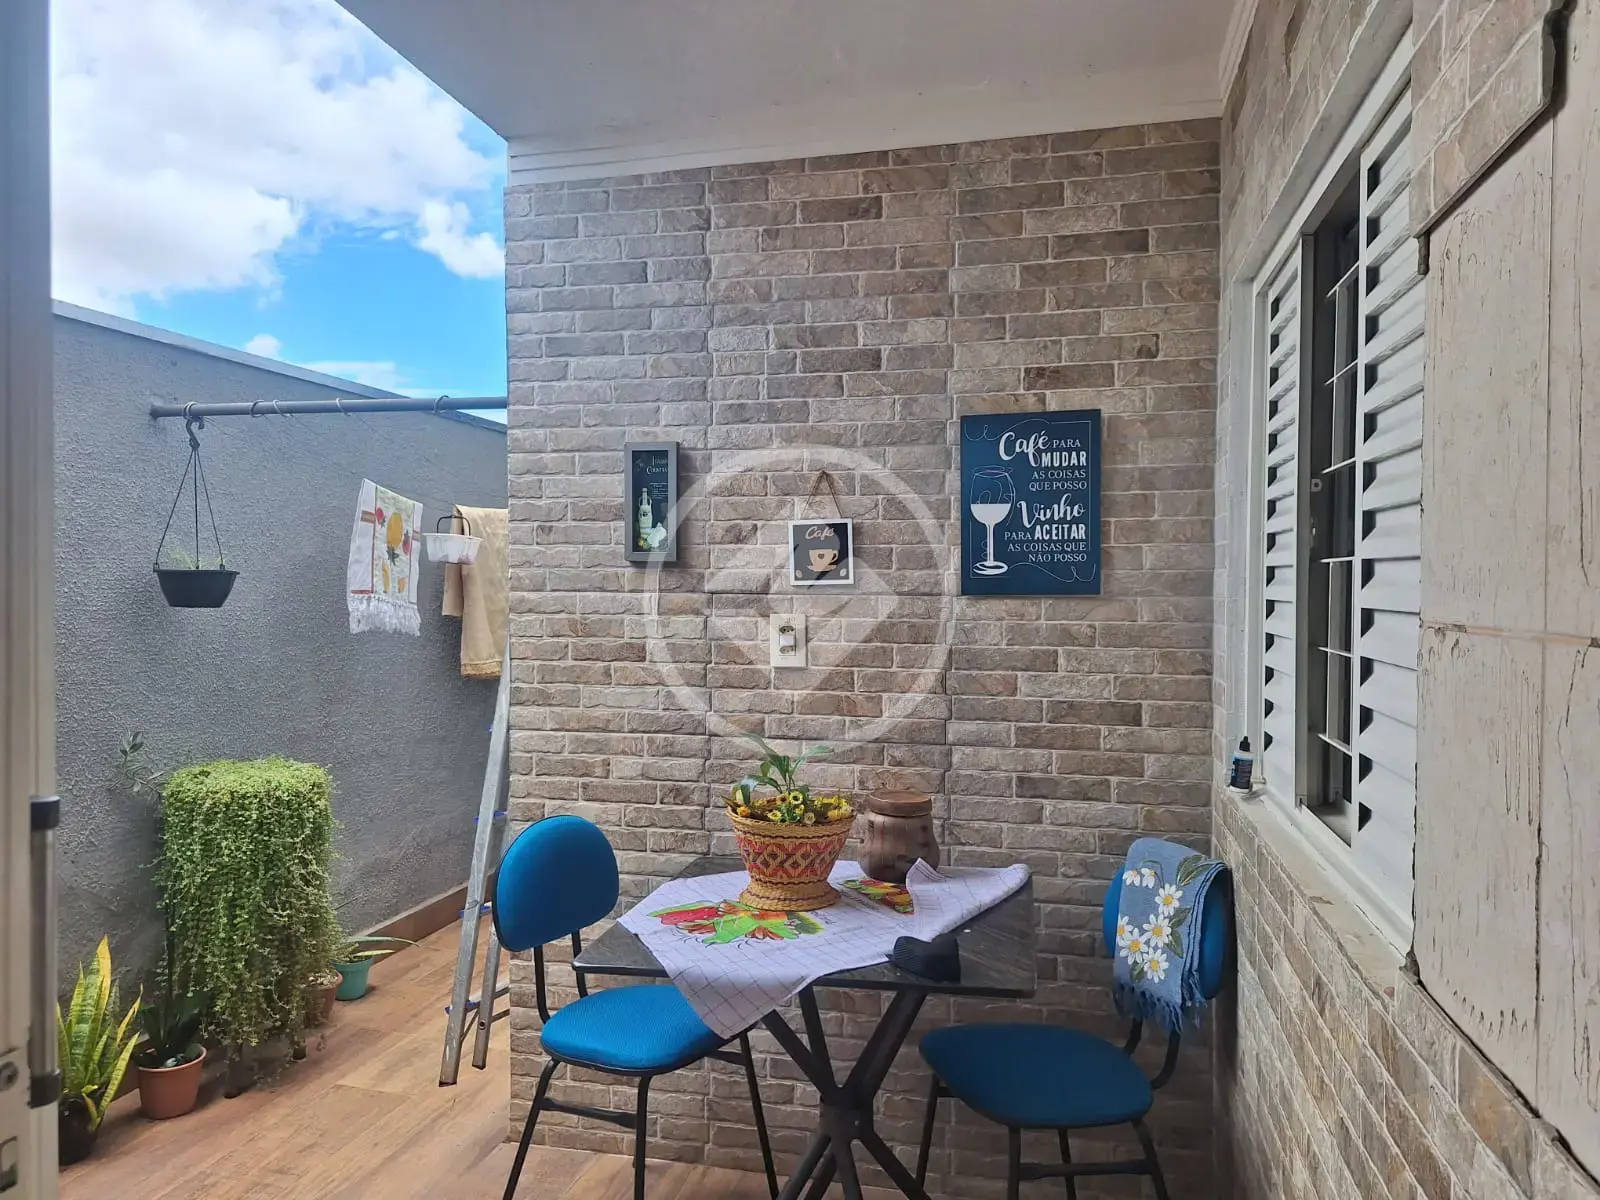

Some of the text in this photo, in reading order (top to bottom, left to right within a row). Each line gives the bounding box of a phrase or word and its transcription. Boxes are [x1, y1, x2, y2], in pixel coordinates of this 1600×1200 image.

[999, 430, 1081, 467] Café PARA
[1041, 451, 1087, 467] MUDAR
[1031, 469, 1087, 480] AS COISAS
[1028, 480, 1088, 492] QUE POSSO
[1016, 493, 1086, 528] Vinho
[1004, 524, 1086, 541] PARA ACEITAR
[1007, 541, 1087, 552] AS COISAS QUE
[1028, 552, 1087, 562] NÃO POSSO
